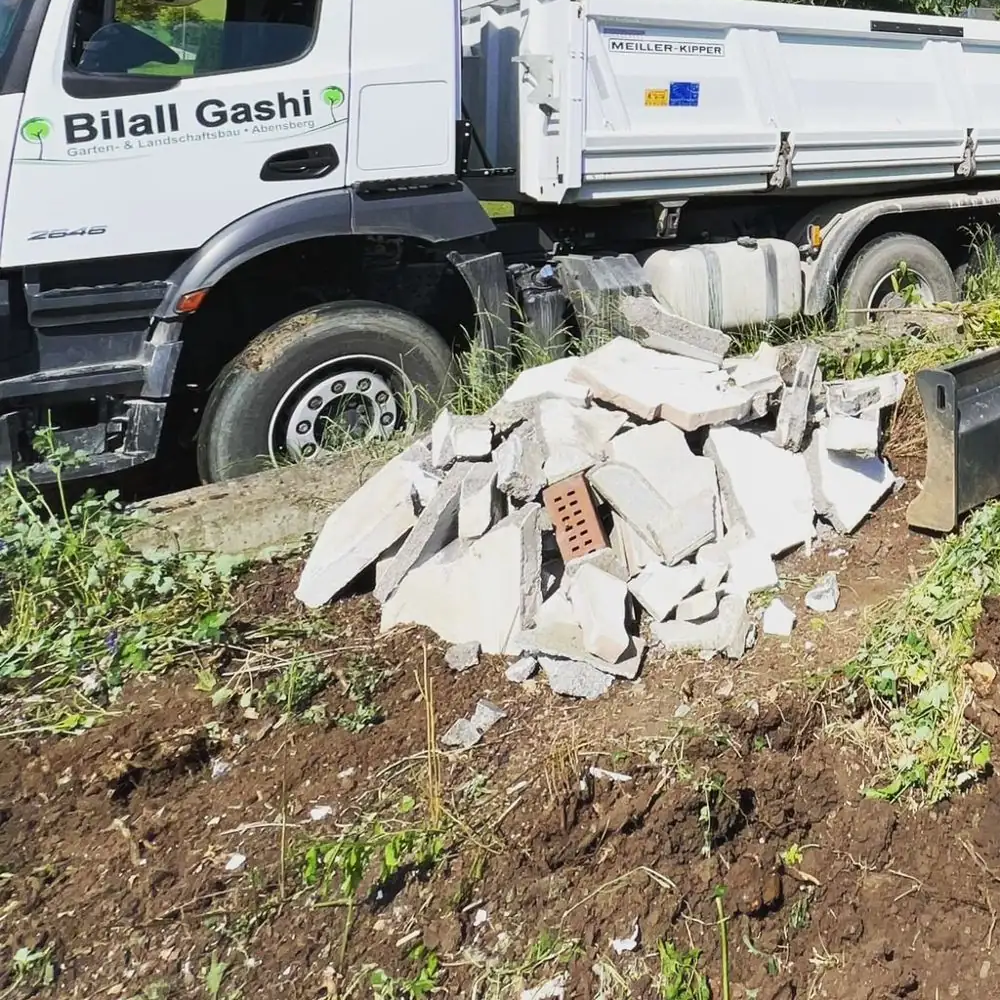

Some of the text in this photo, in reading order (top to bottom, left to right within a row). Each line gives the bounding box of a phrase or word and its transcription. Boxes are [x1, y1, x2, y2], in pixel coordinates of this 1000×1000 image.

[611, 41, 722, 55] MEILLER-KIPPER
[63, 89, 313, 144] Bilall Gashi
[67, 143, 121, 158] Garten-
[124, 140, 134, 151] &
[138, 127, 241, 149] Landschaftsbau
[252, 119, 316, 135] Abensberg
[27, 225, 108, 241] 2646
